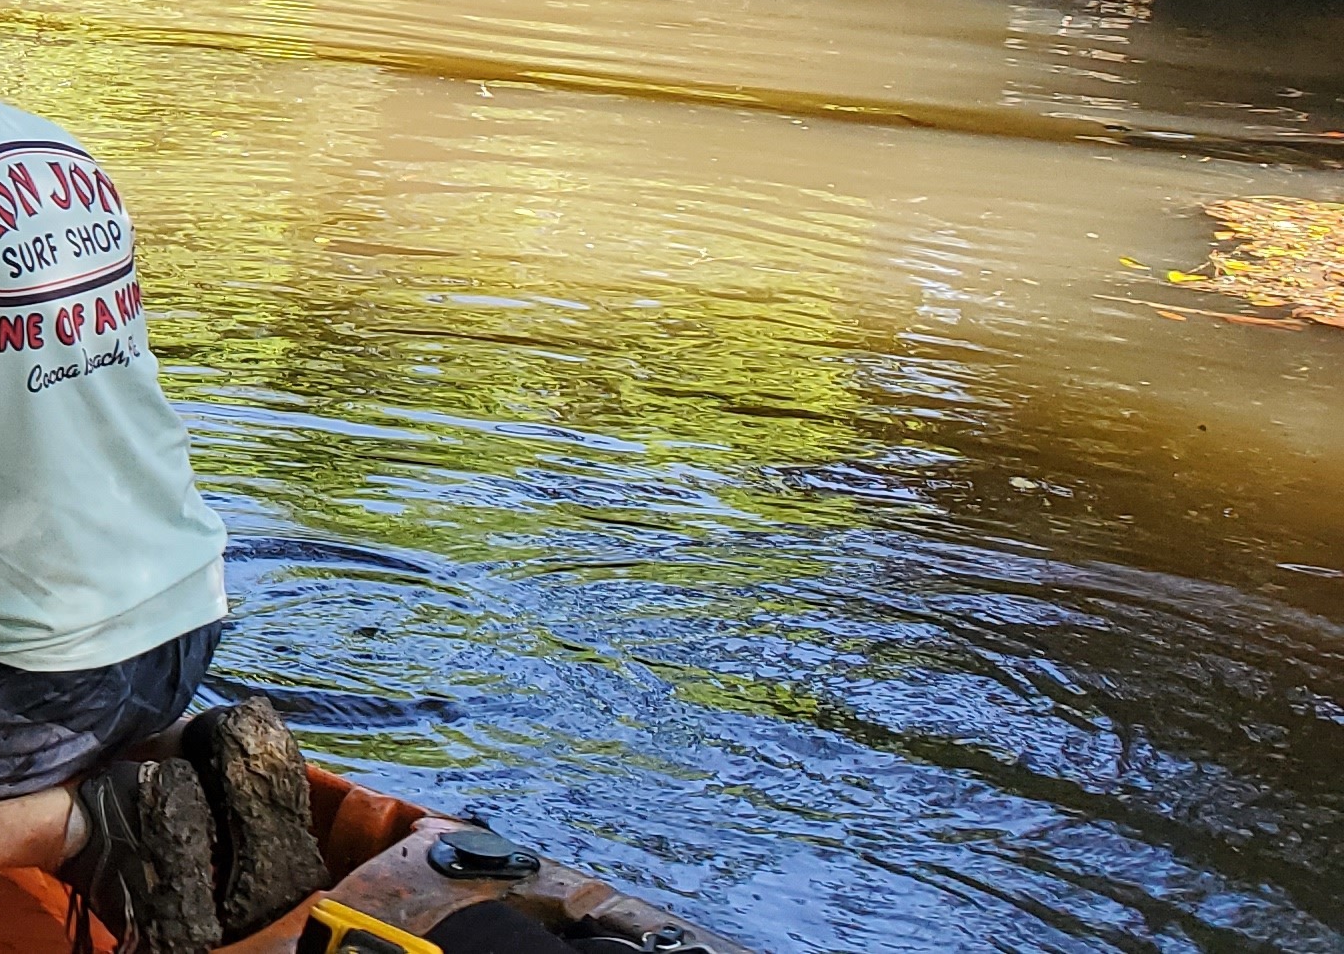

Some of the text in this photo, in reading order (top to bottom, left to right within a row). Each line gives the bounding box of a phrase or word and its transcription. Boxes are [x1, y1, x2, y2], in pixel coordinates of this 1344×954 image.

[45, 161, 123, 216] JON
[1, 219, 122, 279] SURF SHOP
[55, 302, 86, 347] OF
[94, 296, 118, 336] A
[114, 279, 143, 327] KIN
[26, 363, 82, 394] Cocoa
